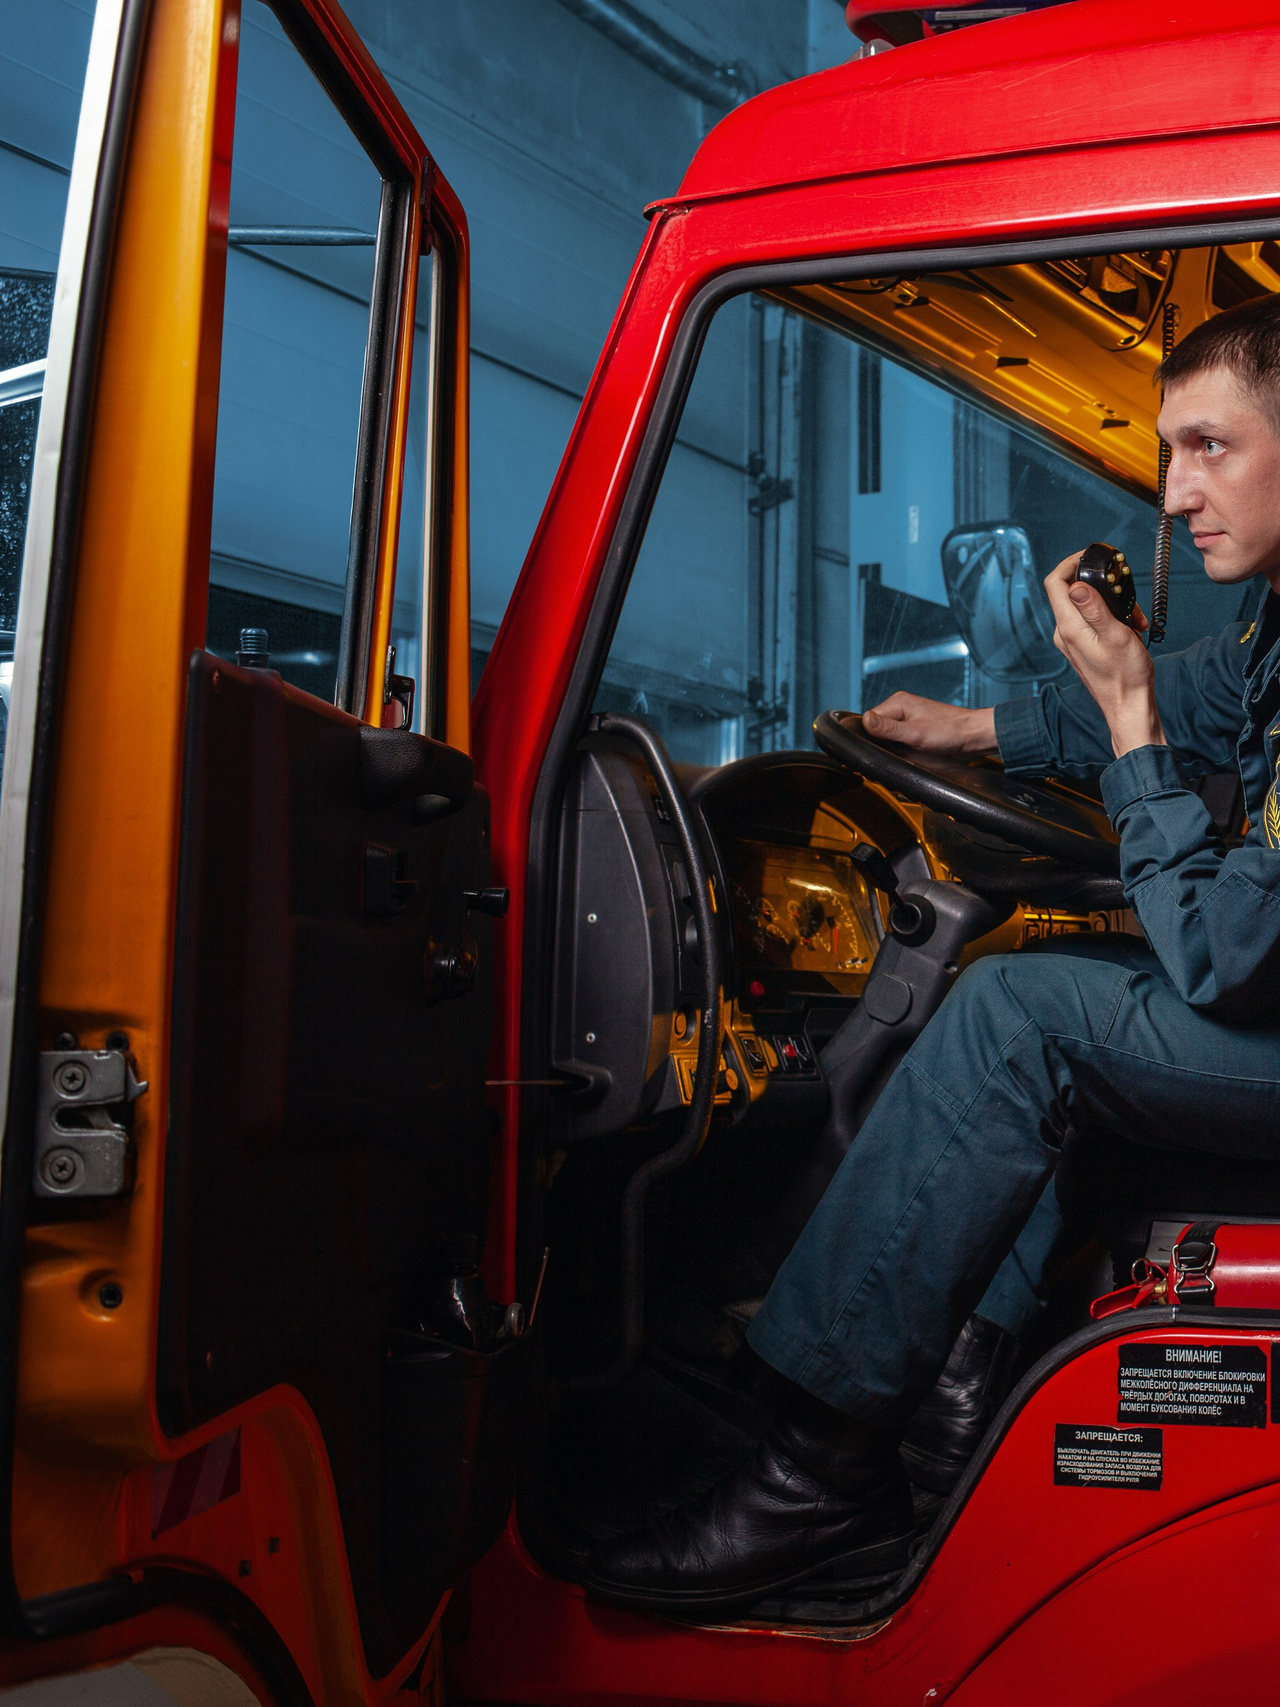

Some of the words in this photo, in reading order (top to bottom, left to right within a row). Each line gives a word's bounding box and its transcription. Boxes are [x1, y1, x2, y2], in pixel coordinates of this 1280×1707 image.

[1166, 1349, 1222, 1363] ВНИМАНИЕ!
[1121, 1367, 1172, 1379] ЗАПРЕЩАЕТСЯ
[1173, 1370, 1217, 1380] ВКЛЮЧЕНИЕ
[1219, 1371, 1265, 1382] БЛОКИРОВКИ
[1121, 1379, 1177, 1389] МЕЖКОЛЁСНОГО
[1178, 1382, 1242, 1393] ДИФФЕРЕНЦИАЛА
[1244, 1384, 1253, 1393] НА
[1121, 1390, 1153, 1401] ТВЁРДЫХ
[1154, 1392, 1188, 1403] ДОРОГАХ,
[1190, 1394, 1232, 1404] ПОВОРОТАХ
[1233, 1395, 1239, 1404] И
[1240, 1396, 1245, 1405] В
[1121, 1402, 1149, 1412] МОМЕНТ
[1151, 1404, 1197, 1414] БУКСОВАНИЯ
[1198, 1405, 1222, 1415] КОЛЁС
[1075, 1431, 1143, 1442] ЗАПРЕЩАЕТСЯ:
